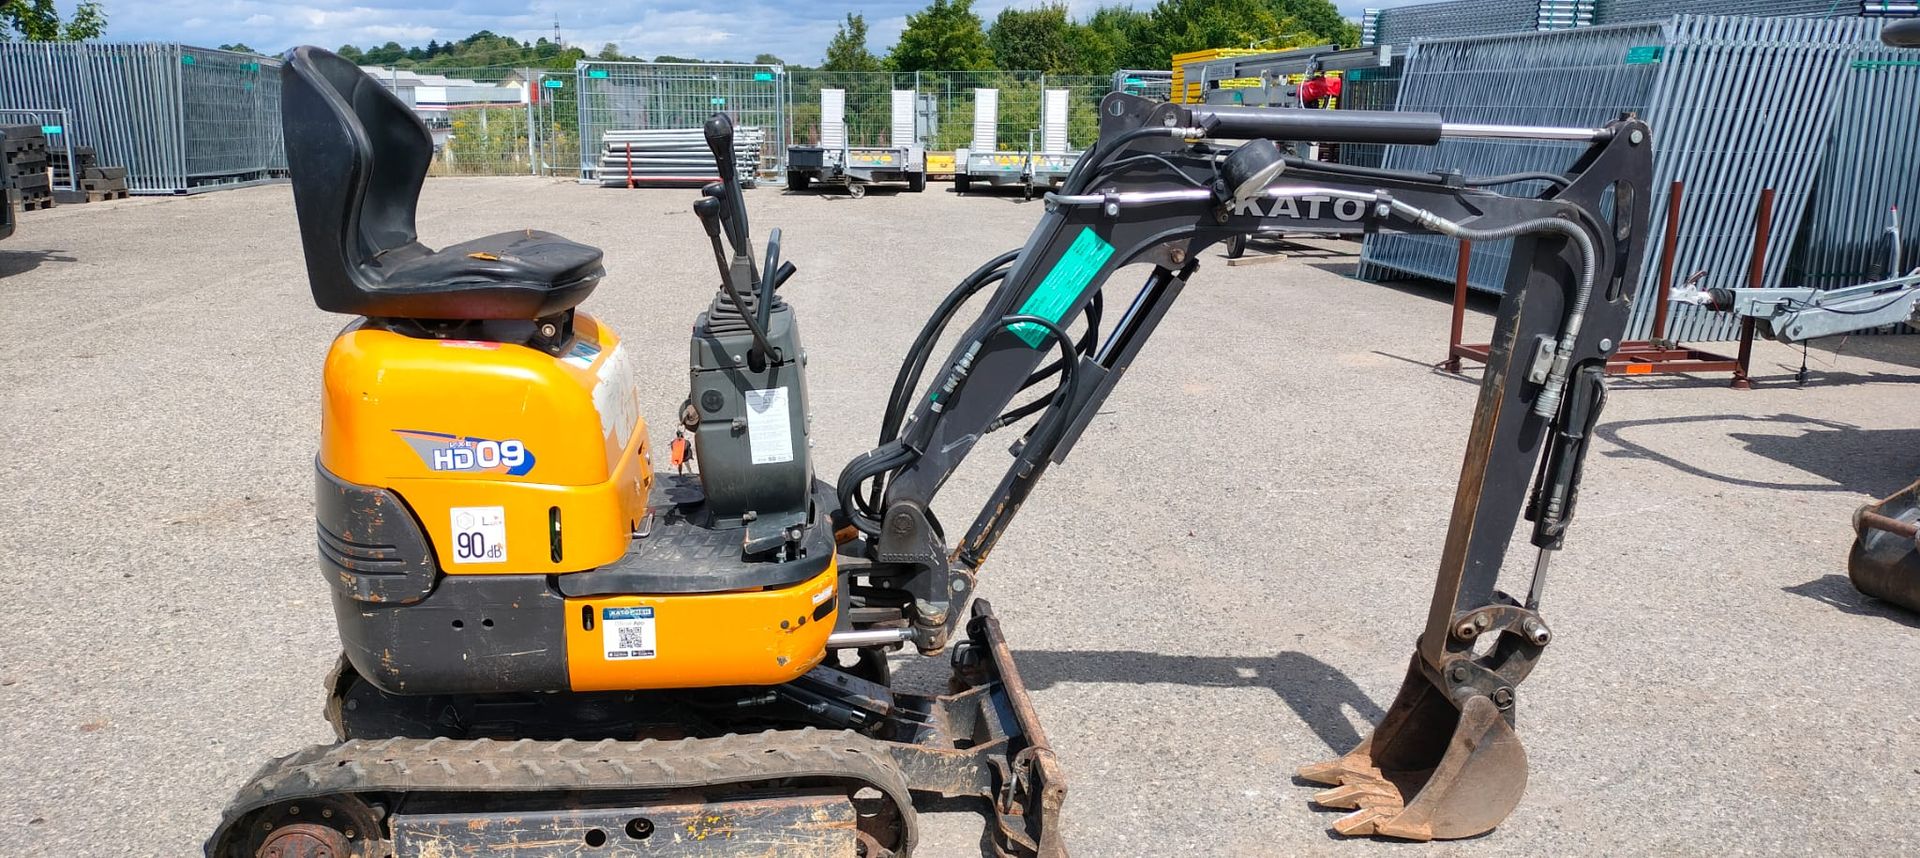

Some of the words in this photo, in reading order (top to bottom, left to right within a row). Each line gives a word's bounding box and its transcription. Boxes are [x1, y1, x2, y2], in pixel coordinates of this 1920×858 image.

[1234, 195, 1366, 221] KATO
[433, 439, 525, 470] HD09
[457, 532, 485, 559] 90
